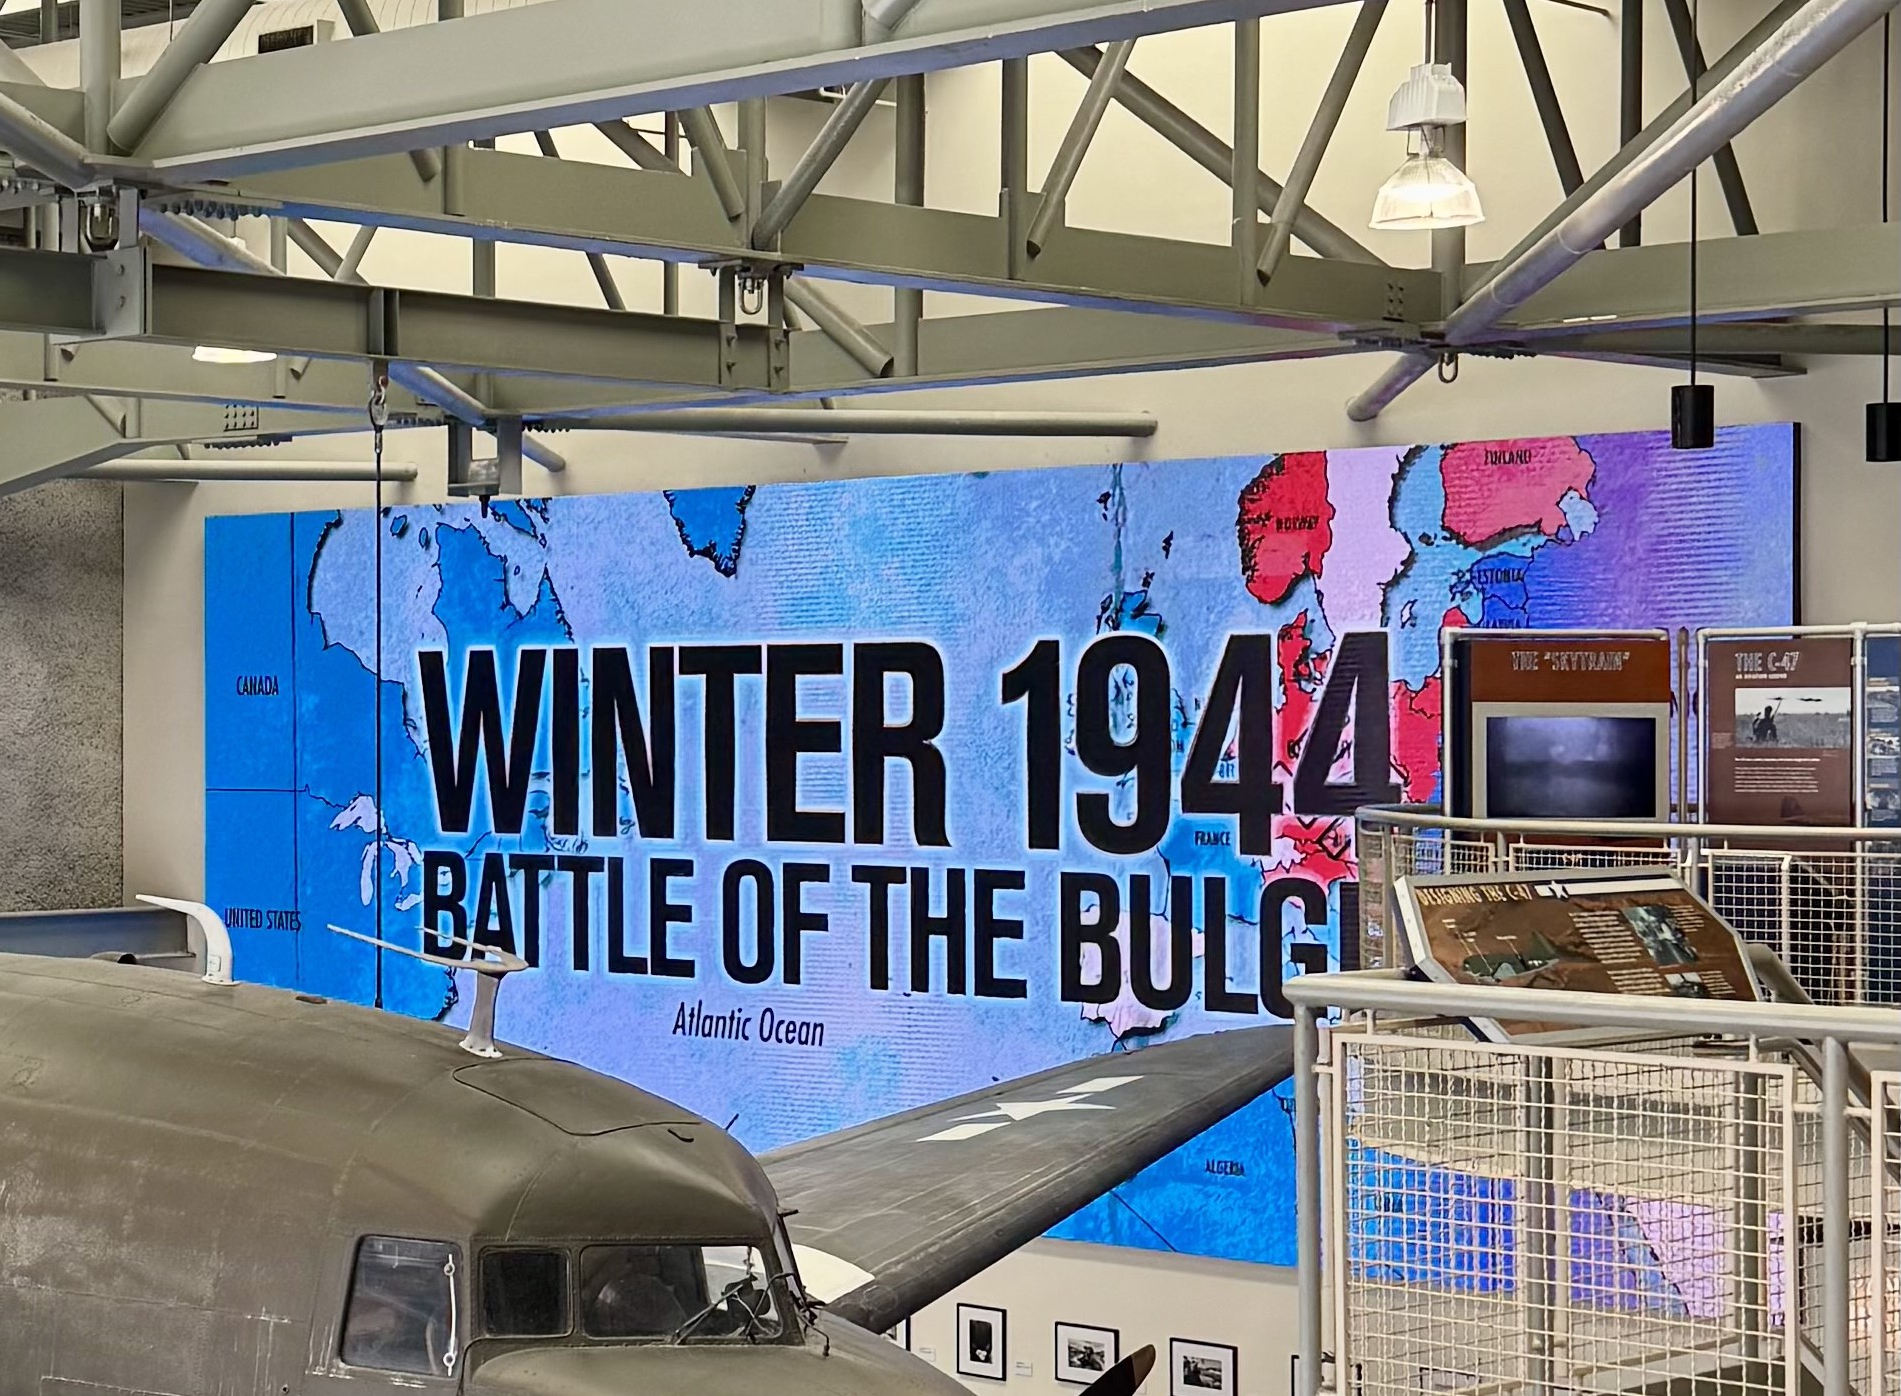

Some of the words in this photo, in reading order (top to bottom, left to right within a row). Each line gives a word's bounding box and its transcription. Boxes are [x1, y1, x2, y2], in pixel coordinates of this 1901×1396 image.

[1735, 652, 1763, 672] THE
[1767, 651, 1799, 672] C-47
[236, 675, 279, 696] CANADA
[418, 641, 951, 847] WINTER
[1001, 631, 1402, 857] 1944
[1194, 830, 1230, 847] FRANCE
[1415, 886, 1483, 906] DESIGNING
[1480, 885, 1507, 902] THE
[224, 907, 263, 929] UNITED
[266, 909, 302, 932] STATES
[423, 851, 695, 978] BATTLE
[722, 858, 831, 985] OF
[852, 864, 1027, 999] THE
[672, 999, 752, 1041] Atlantic
[759, 1007, 825, 1047] Ocean
